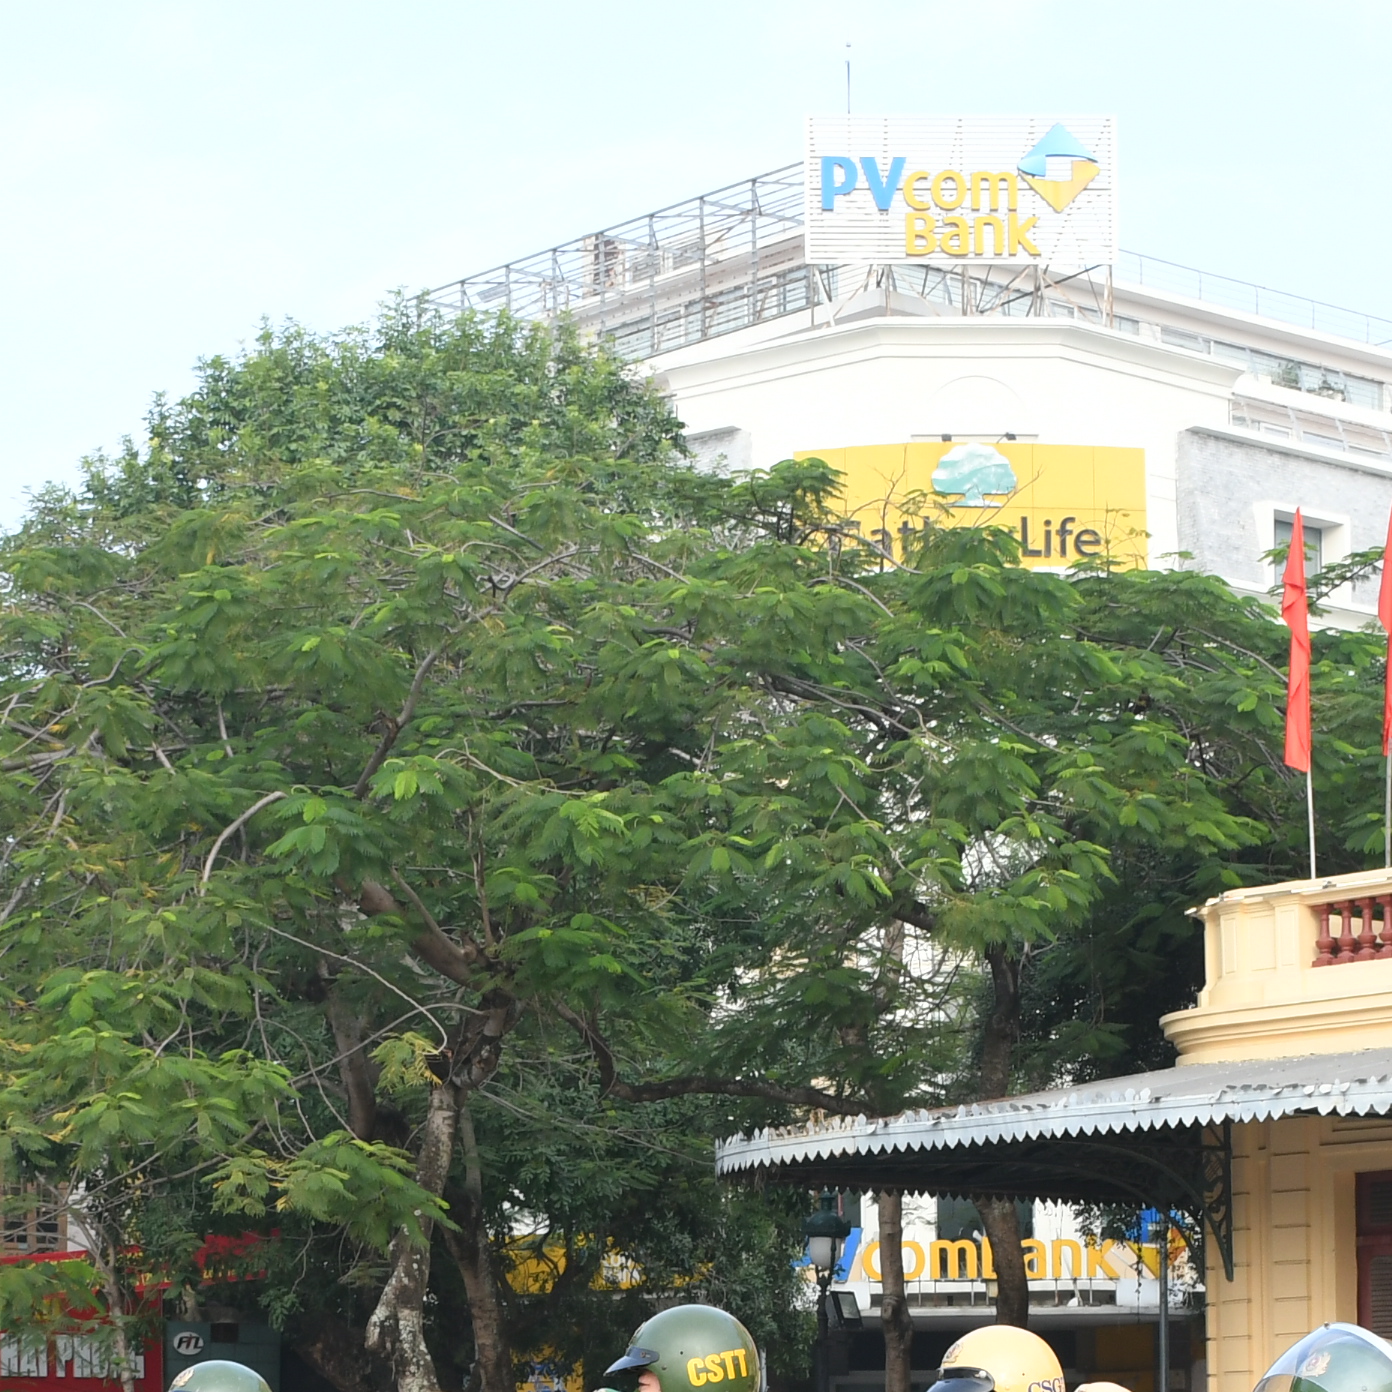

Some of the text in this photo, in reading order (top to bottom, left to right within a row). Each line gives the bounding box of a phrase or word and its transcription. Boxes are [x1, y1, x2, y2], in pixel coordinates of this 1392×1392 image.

[820, 156, 1018, 211] PVcom
[905, 213, 1042, 256] Bank
[686, 1348, 748, 1388] CSTT
